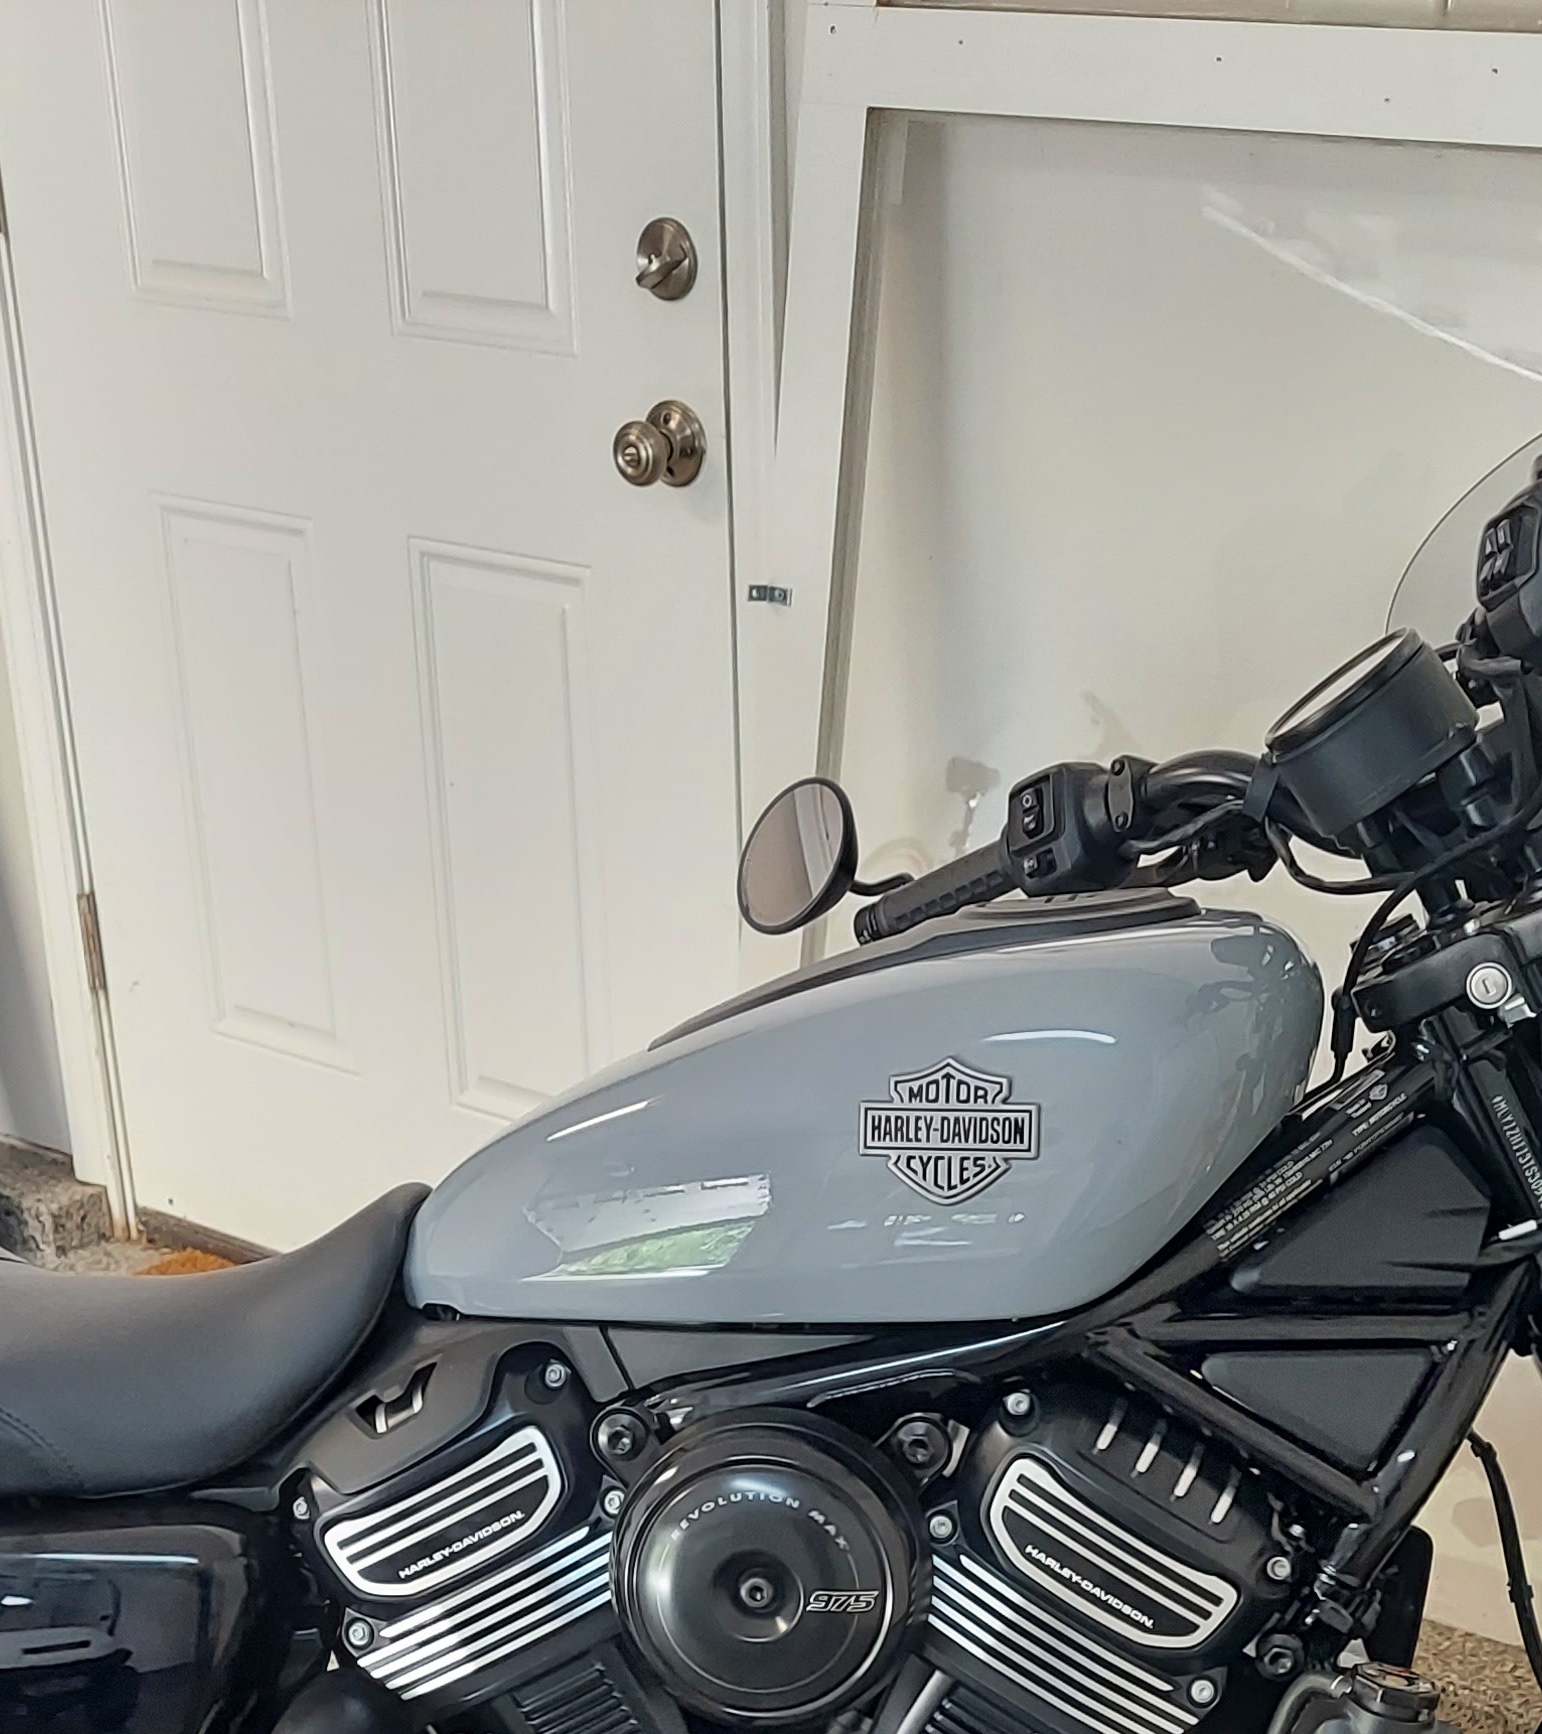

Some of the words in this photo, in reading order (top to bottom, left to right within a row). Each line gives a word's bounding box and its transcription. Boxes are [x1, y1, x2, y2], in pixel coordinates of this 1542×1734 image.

[909, 1071, 989, 1105] MOTOR
[870, 1114, 1026, 1145] HARLEY-DAVIDSON
[905, 1155, 986, 1191] CYCLES
[670, 1491, 800, 1541] REVOLUTION
[808, 1510, 849, 1550] MAX
[806, 1590, 879, 1613] 975
